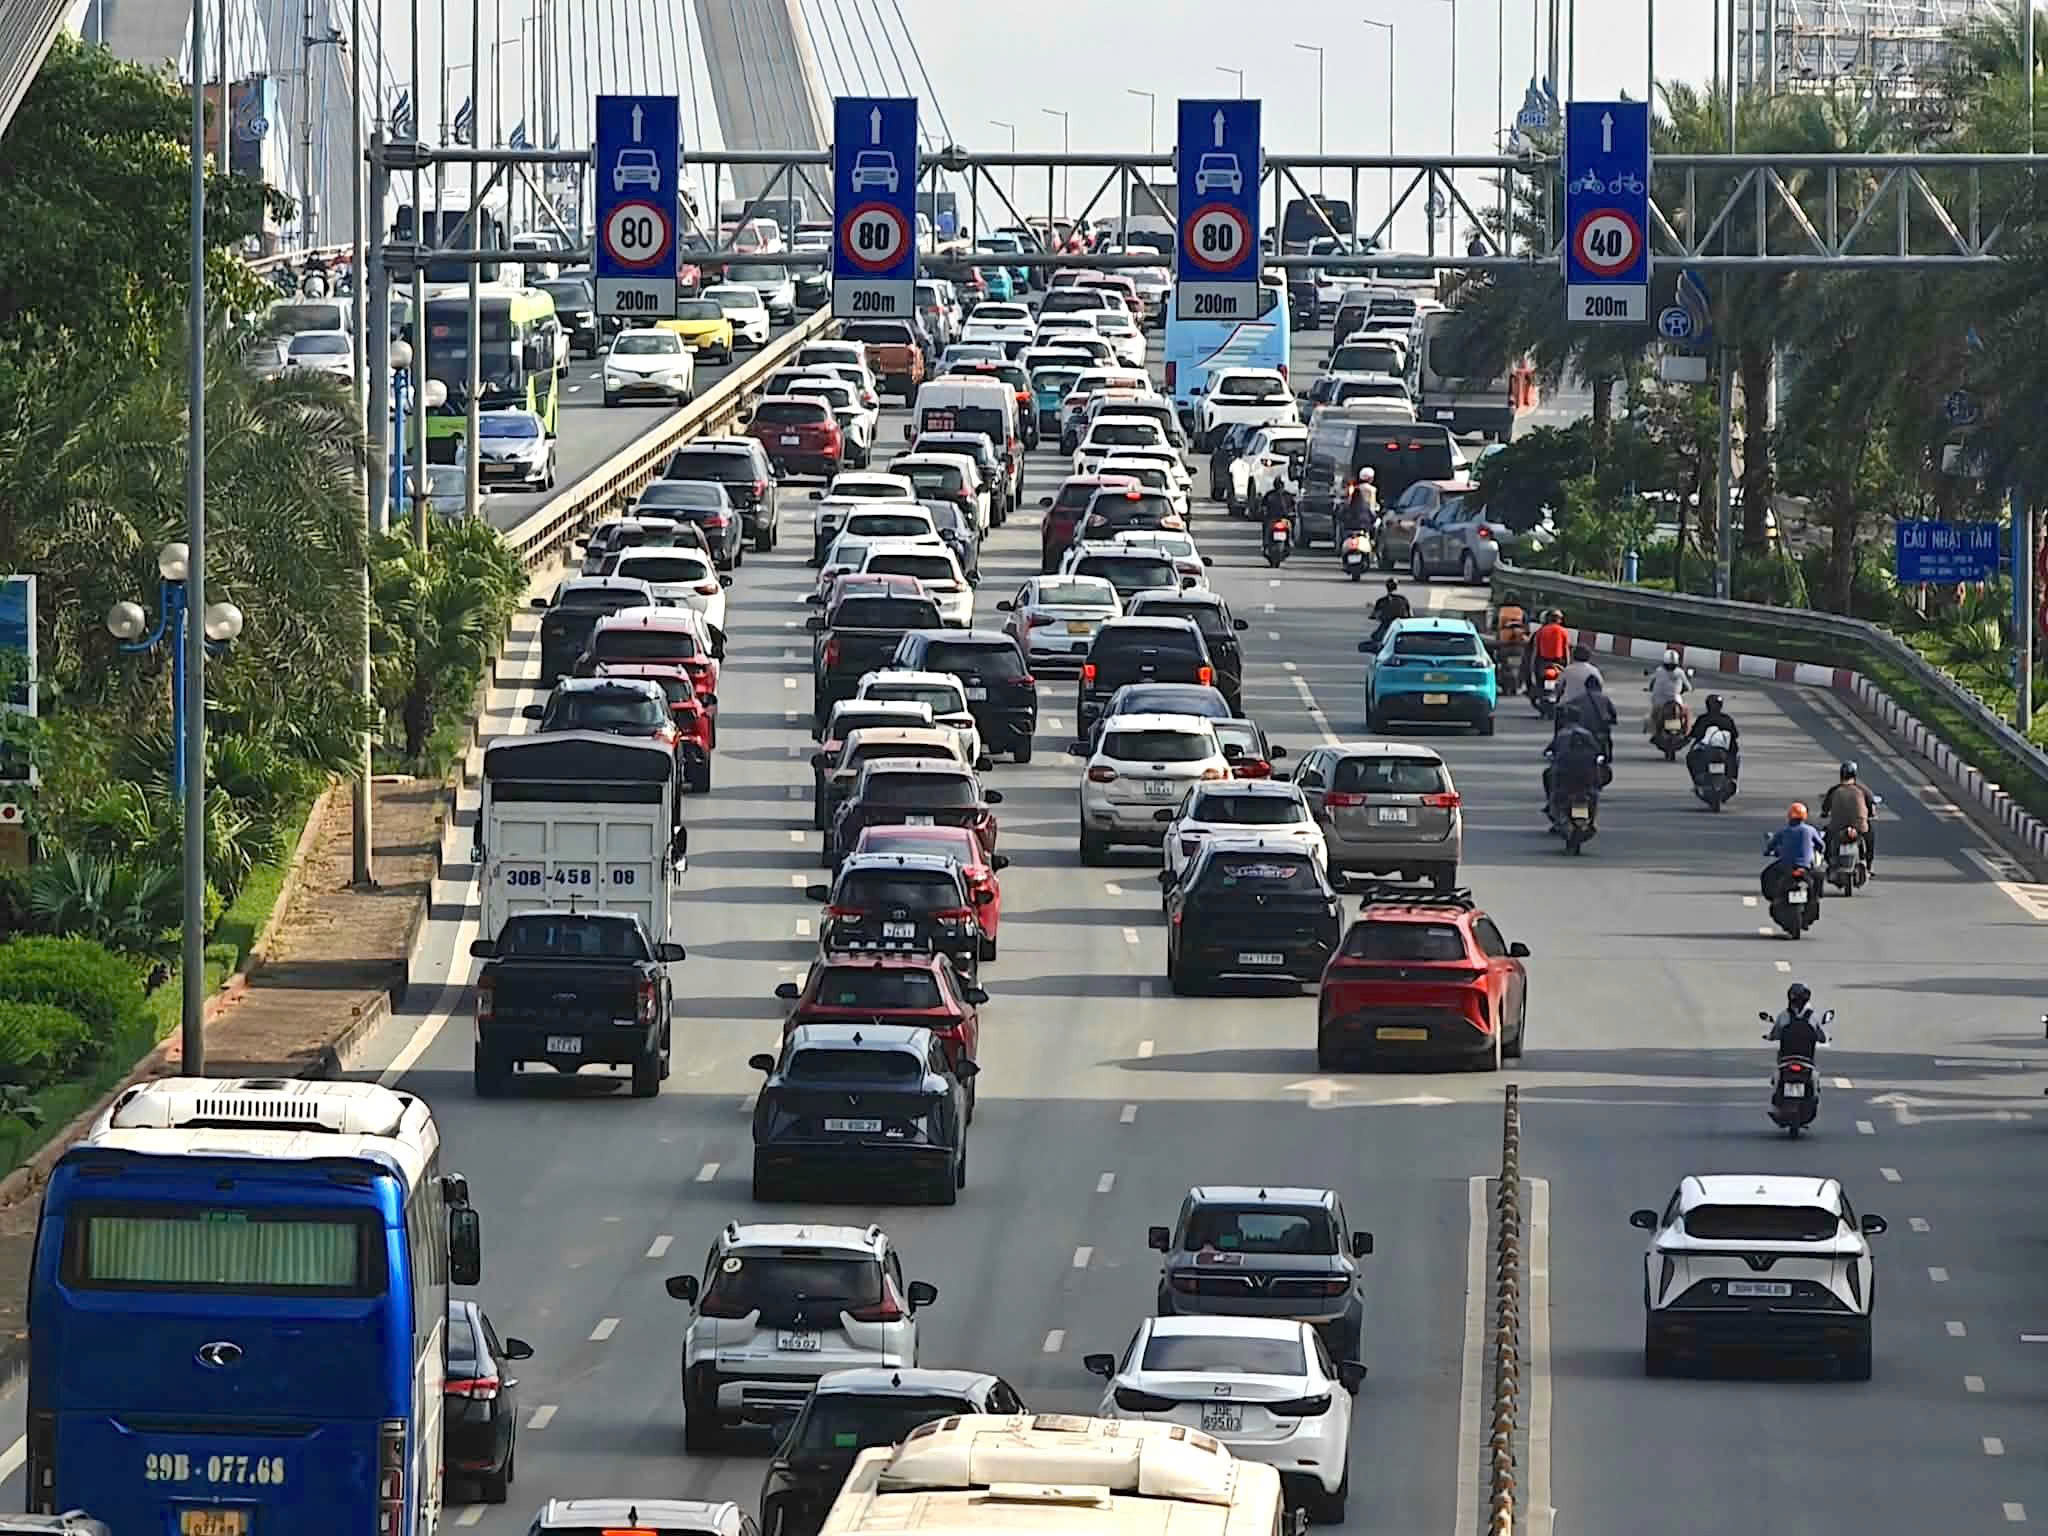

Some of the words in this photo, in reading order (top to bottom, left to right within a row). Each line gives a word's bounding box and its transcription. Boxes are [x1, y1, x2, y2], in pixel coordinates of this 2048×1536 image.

[621, 217, 652, 249] 80
[859, 222, 890, 250] 80
[1202, 224, 1233, 252] 80
[1591, 229, 1622, 257] 40
[616, 290, 658, 311] 200m
[852, 291, 895, 312] 200m
[1194, 294, 1237, 314] 200m
[1585, 296, 1627, 317] 200m
